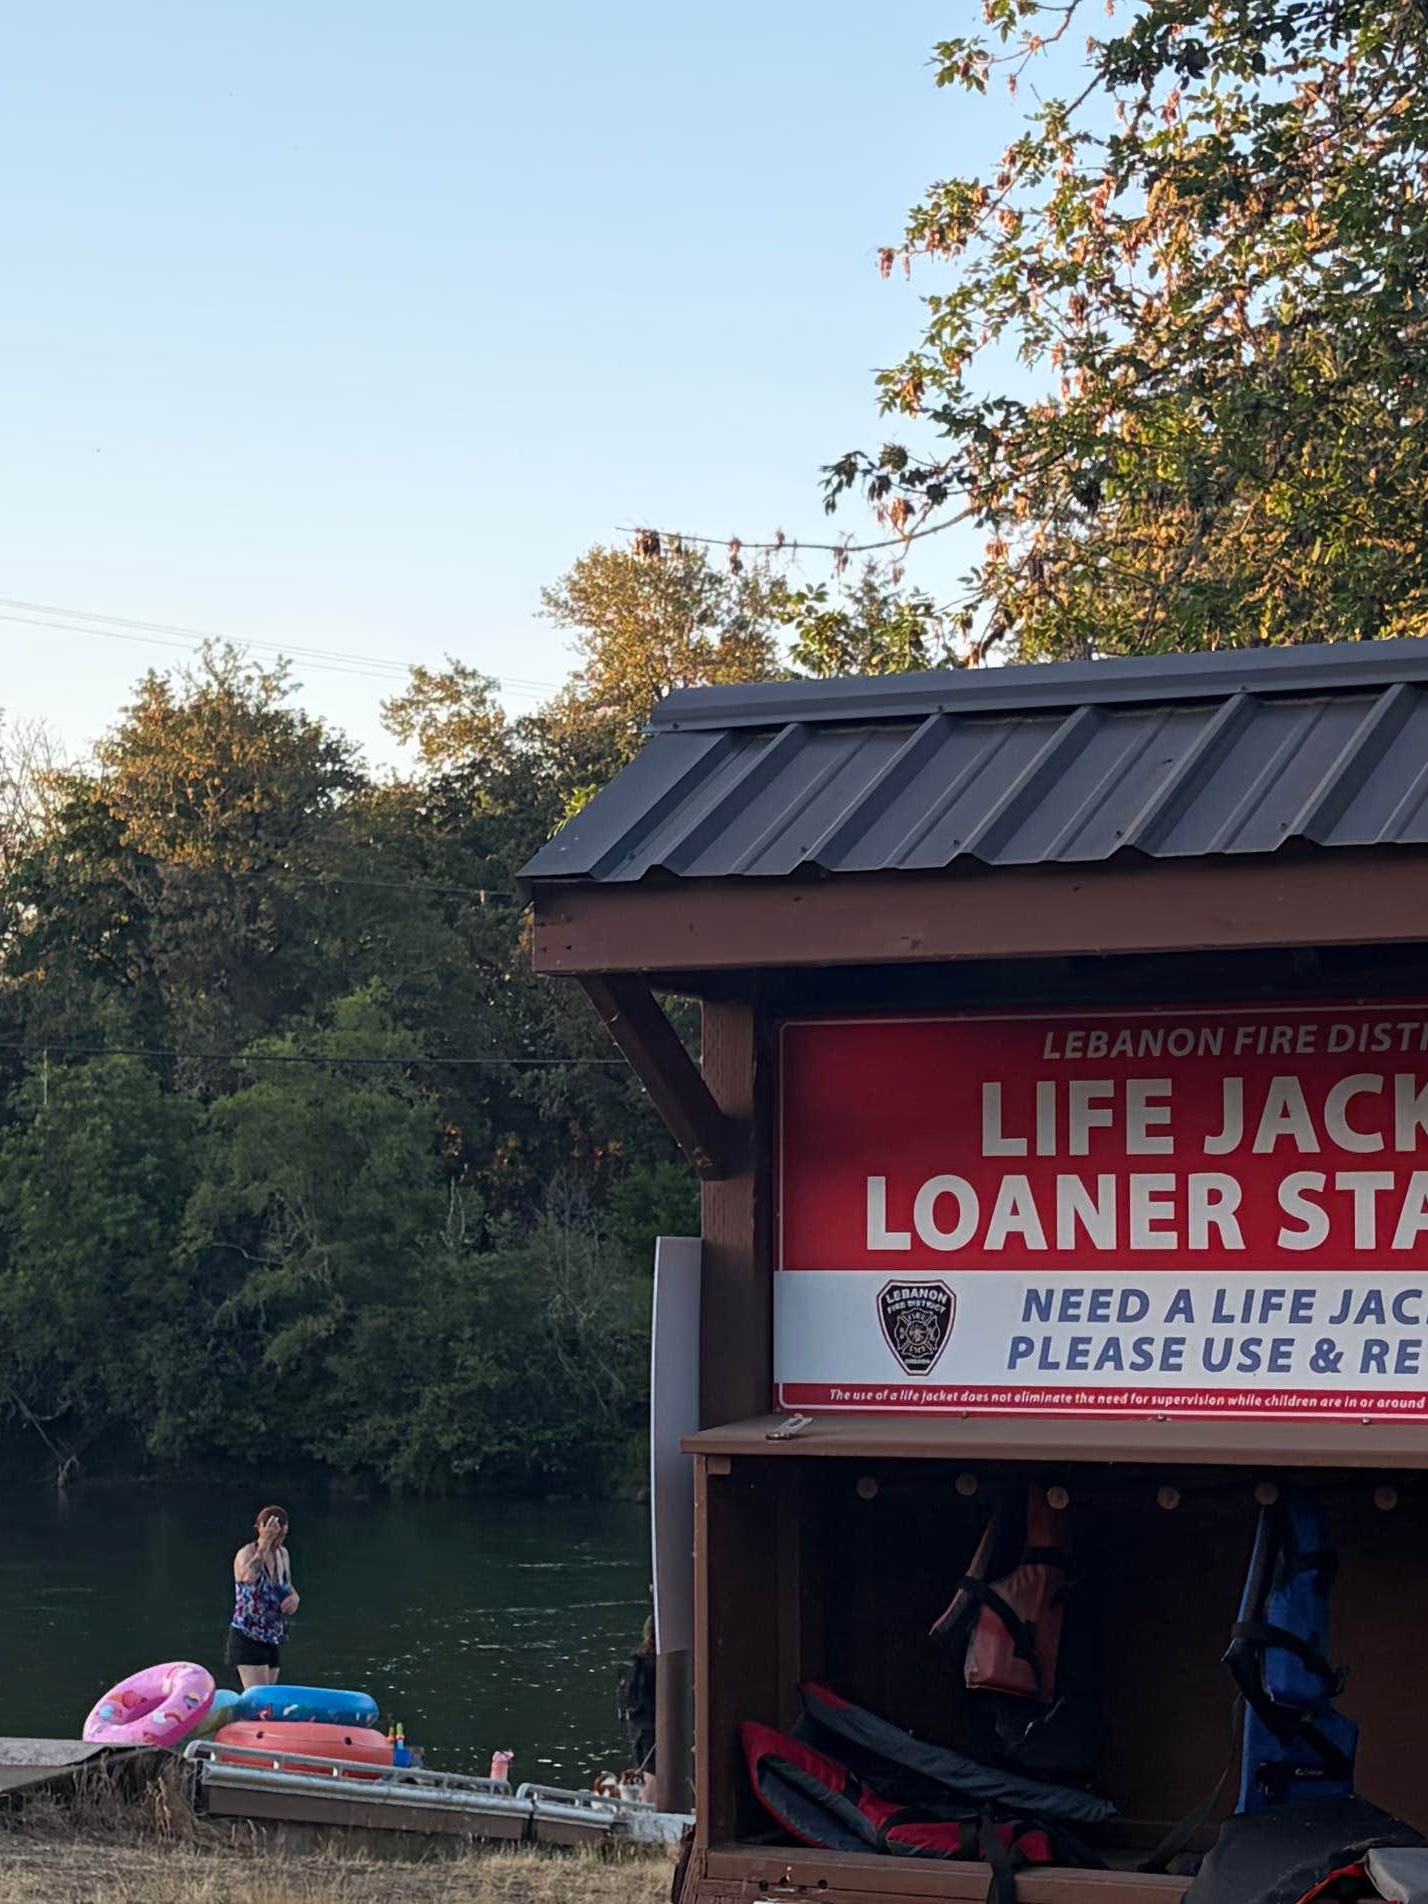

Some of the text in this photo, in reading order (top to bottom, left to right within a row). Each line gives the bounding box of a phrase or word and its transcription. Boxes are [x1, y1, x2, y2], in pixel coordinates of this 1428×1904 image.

[1043, 1027, 1224, 1060] LEBANON
[1233, 1025, 1318, 1055] FIRE
[982, 1079, 1174, 1157] LIFE
[867, 1172, 1243, 1251] LOANER
[885, 1288, 948, 1304] LEBANON
[1022, 1288, 1150, 1323] NEED
[1164, 1289, 1194, 1323] A
[1211, 1289, 1317, 1324] LIFE
[1007, 1336, 1186, 1372] PLEASE
[1202, 1337, 1296, 1373] USE
[1309, 1337, 1344, 1374] &
[830, 1389, 851, 1400] The
[853, 1392, 873, 1400] use
[875, 1389, 889, 1400] of
[899, 1389, 919, 1401] life
[921, 1390, 958, 1404] jacket
[960, 1391, 989, 1402] does
[991, 1392, 1012, 1402] not
[1014, 1391, 1073, 1403] eliminate
[1075, 1392, 1095, 1404] the
[1097, 1393, 1128, 1404] need
[1130, 1393, 1149, 1405] for
[1151, 1394, 1225, 1407] supervision
[1227, 1394, 1262, 1406] while
[1264, 1394, 1318, 1407] children
[1320, 1398, 1342, 1407] are
[1359, 1398, 1374, 1408] or
[1376, 1397, 1426, 1409] around
